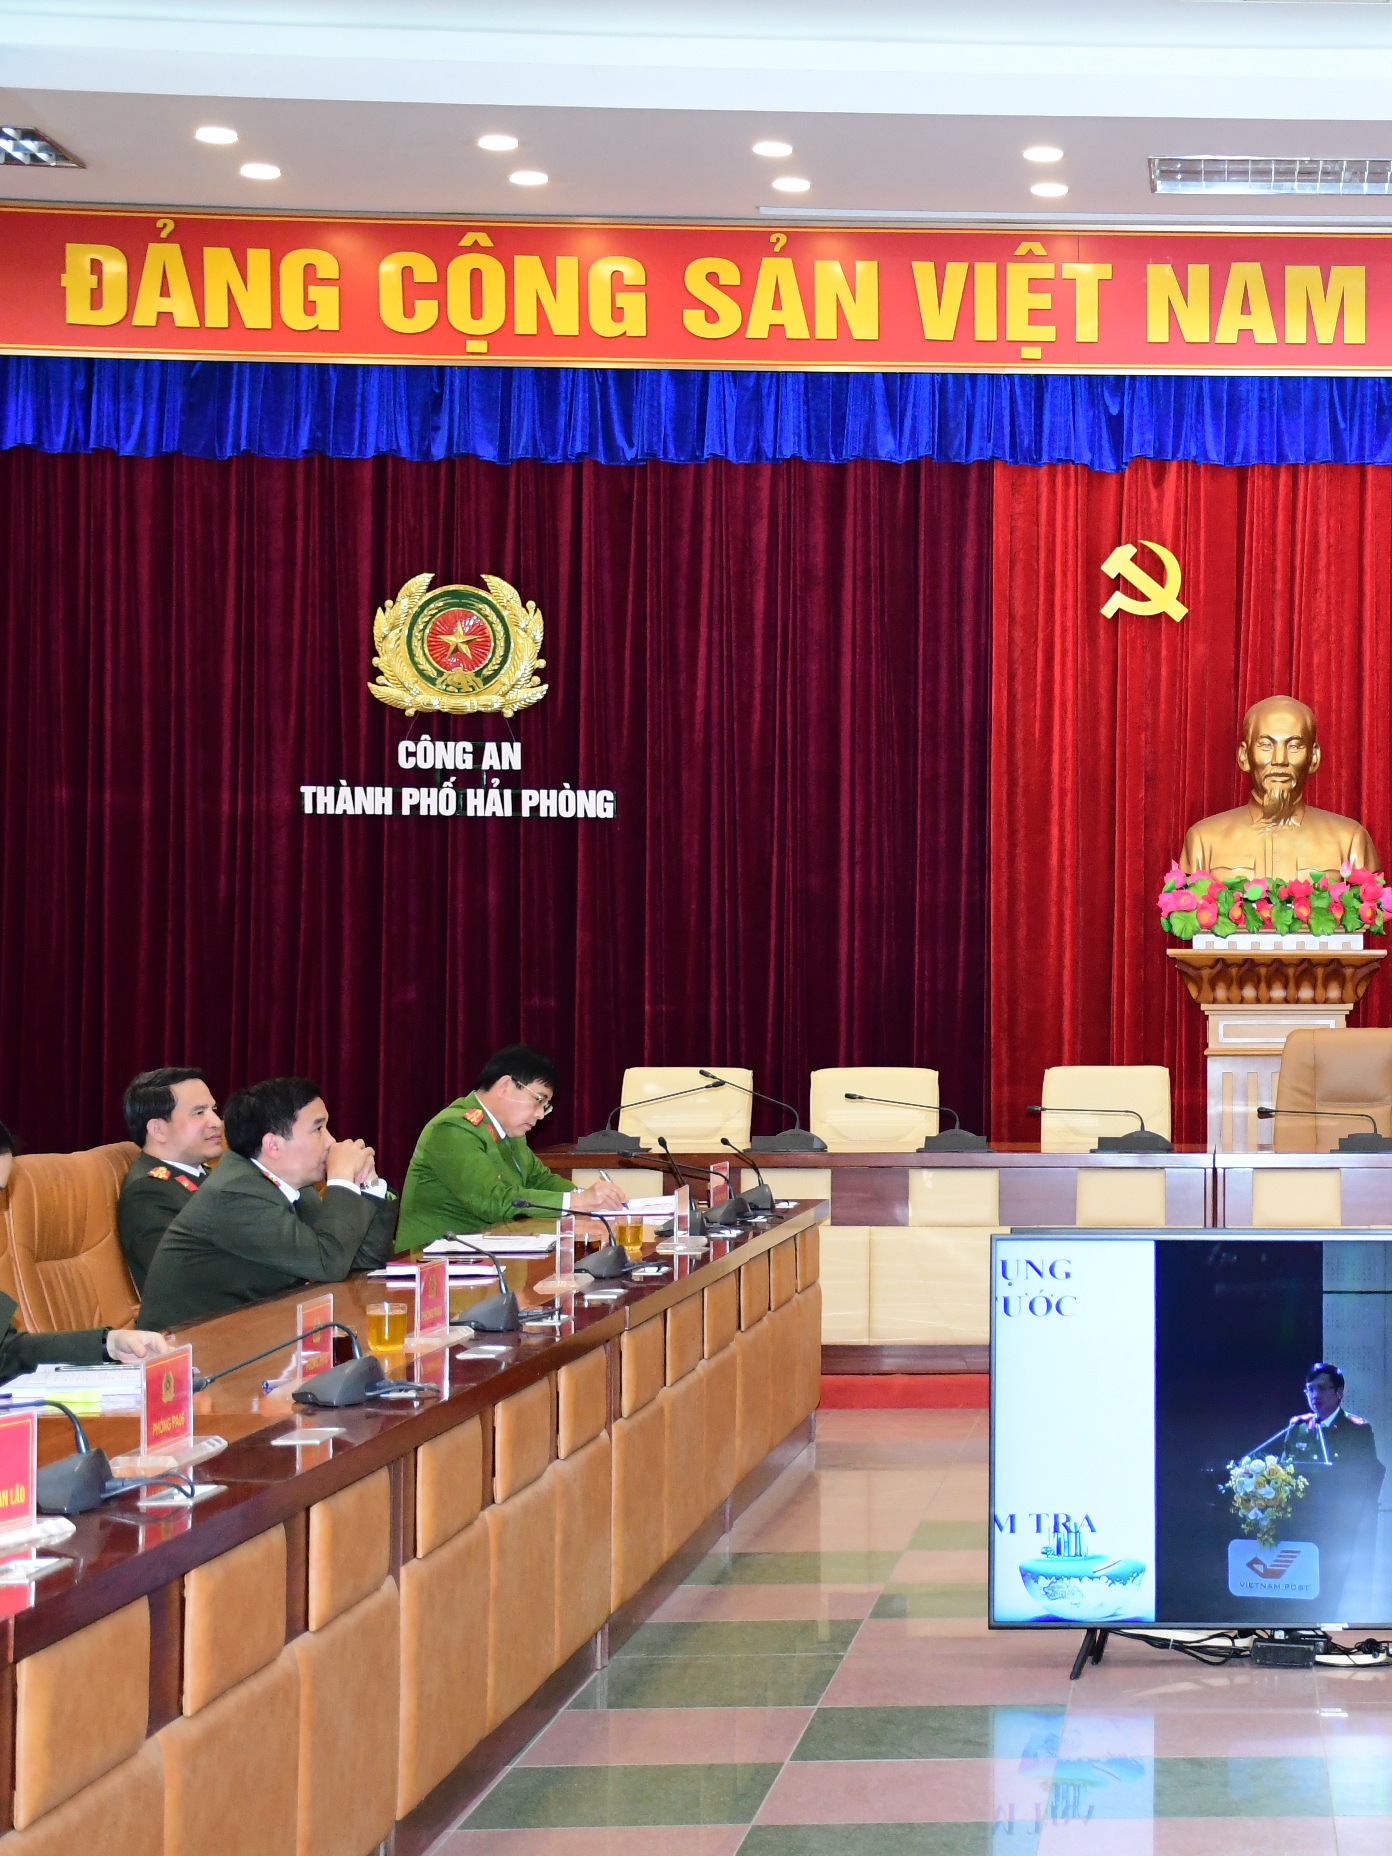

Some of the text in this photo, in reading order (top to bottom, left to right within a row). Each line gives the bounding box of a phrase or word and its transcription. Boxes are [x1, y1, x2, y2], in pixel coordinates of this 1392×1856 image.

[60, 219, 340, 332] ĐẢNG
[378, 232, 648, 353] CỘNG
[682, 233, 880, 342] SẢN
[911, 241, 1113, 359] VIỆT
[1146, 263, 1367, 345] NAM
[398, 735, 521, 769] CÔNG AN
[301, 776, 614, 818] THÀNH PHỐ HẢI PHÒNG
[1000, 1259, 1071, 1286] ỤNG
[1029, 1513, 1096, 1533] TRA
[1240, 1582, 1280, 1590] VIETNAM
